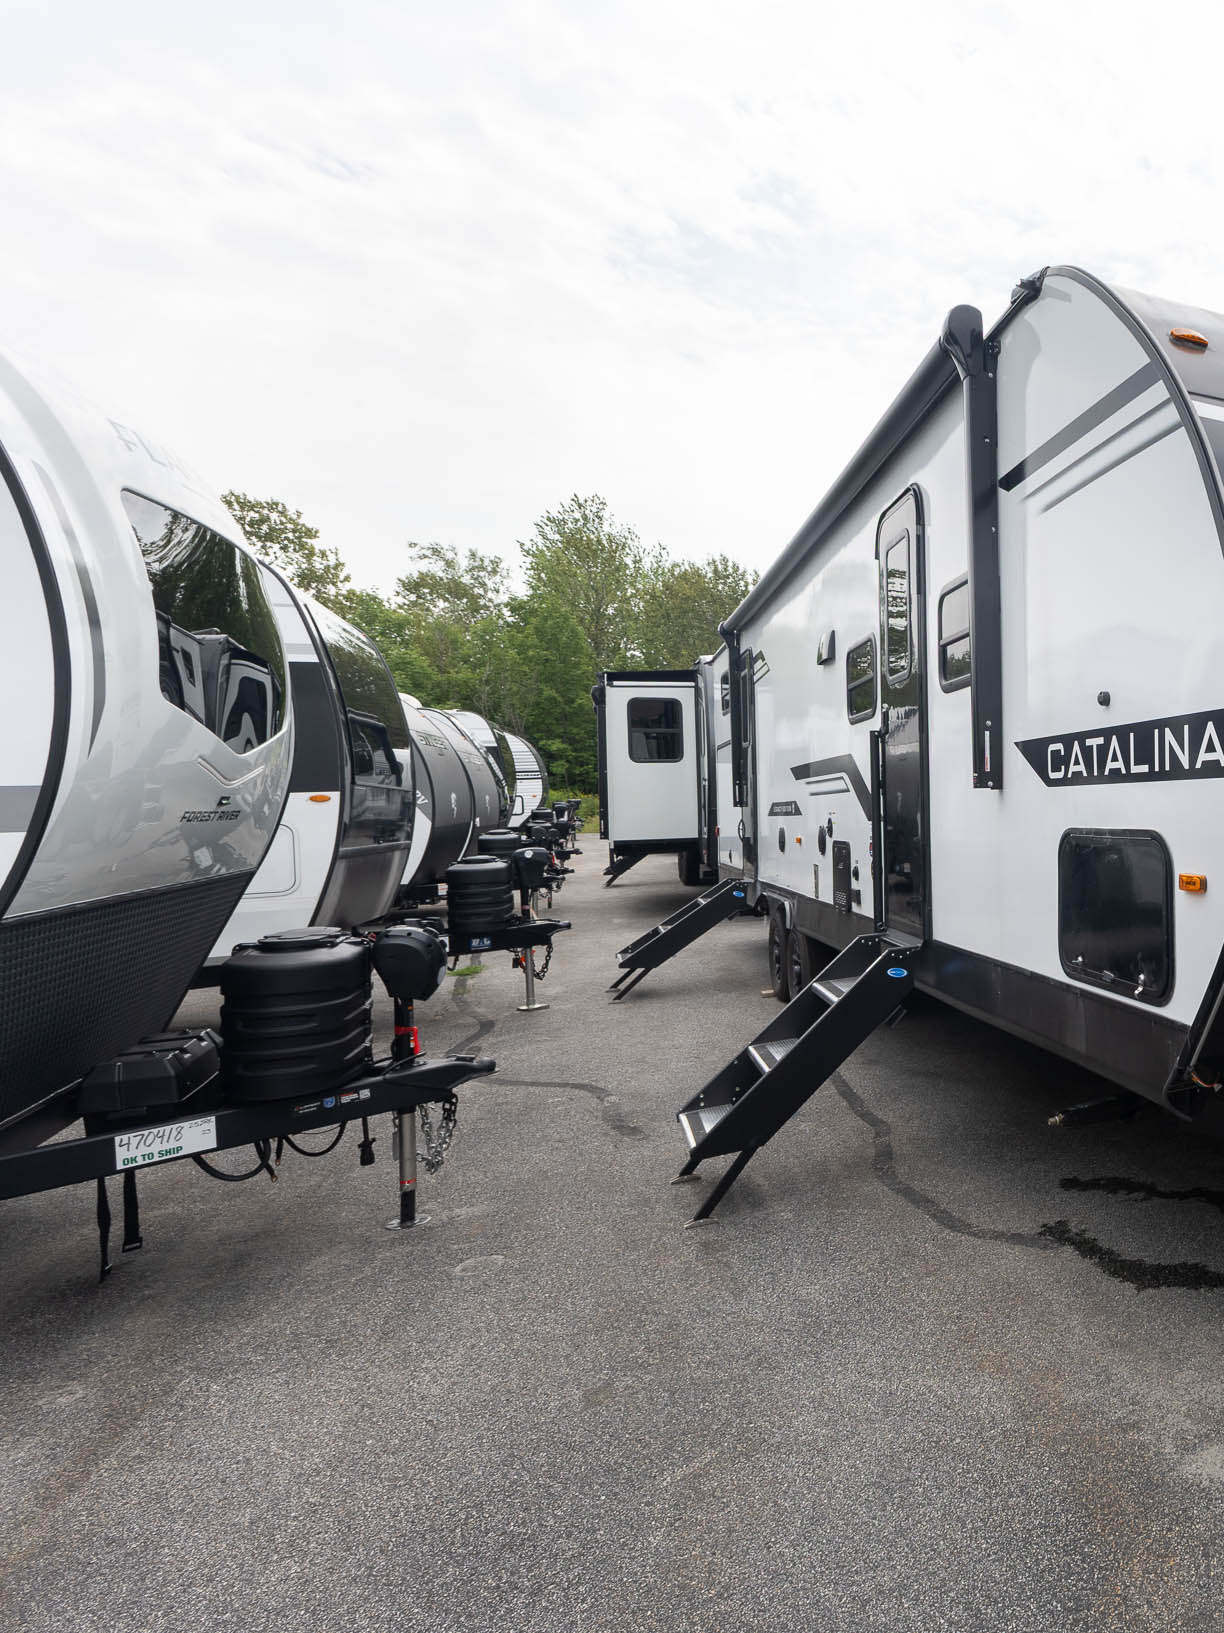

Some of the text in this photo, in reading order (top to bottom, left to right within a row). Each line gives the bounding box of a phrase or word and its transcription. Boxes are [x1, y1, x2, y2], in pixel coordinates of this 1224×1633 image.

[180, 810, 219, 823] FOREST
[118, 1125, 184, 1152] 470418
[122, 1145, 183, 1166] OK TO SHIP
